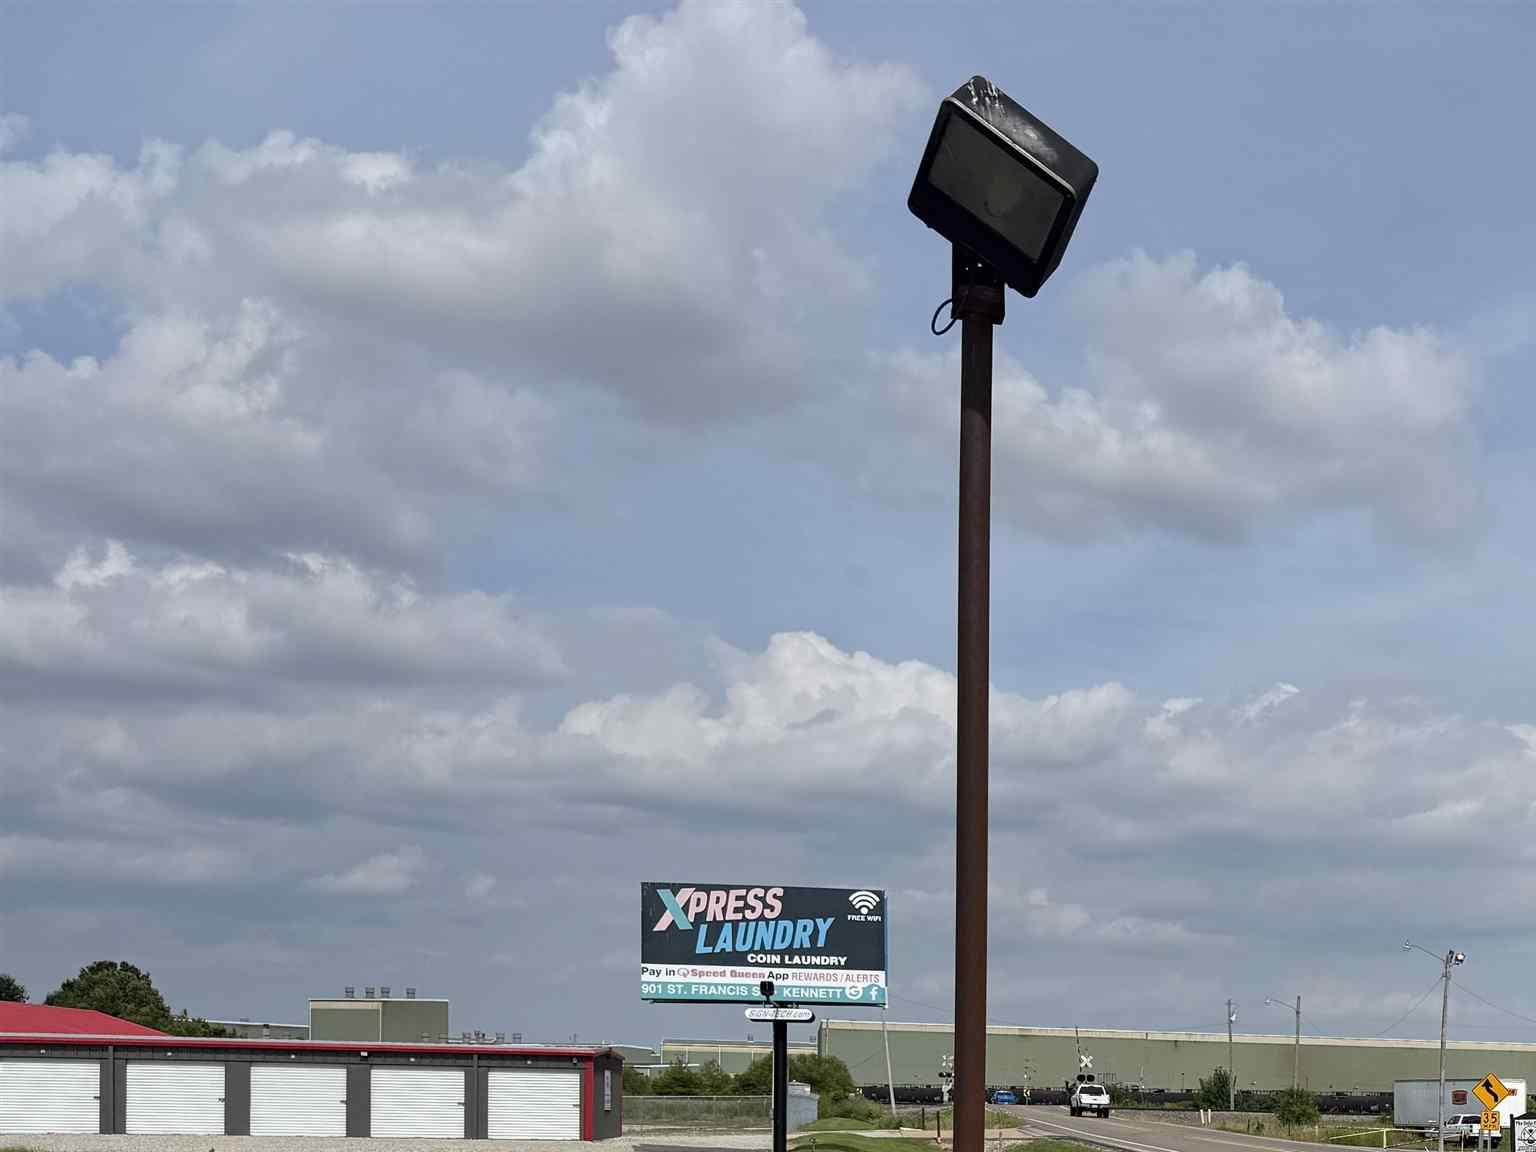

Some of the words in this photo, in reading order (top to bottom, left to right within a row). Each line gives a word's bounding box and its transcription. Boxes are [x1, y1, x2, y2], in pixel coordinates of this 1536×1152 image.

[653, 887, 784, 932] XPRESS
[695, 917, 835, 954] LAUNDRY
[747, 953, 781, 964] COIN
[785, 955, 847, 966] LAUNDRY
[641, 967, 662, 978] Pay
[665, 967, 675, 976] in
[691, 969, 726, 978] Speed
[730, 969, 765, 979] Queen
[768, 971, 789, 981] App
[792, 972, 838, 982] REWARDS
[845, 975, 880, 983] ALERTS
[641, 983, 662, 994] 901
[668, 984, 687, 994] ST.
[691, 984, 747, 995] FRANCIS
[783, 988, 843, 998] KENNETT
[1483, 1112, 1497, 1124] 35
